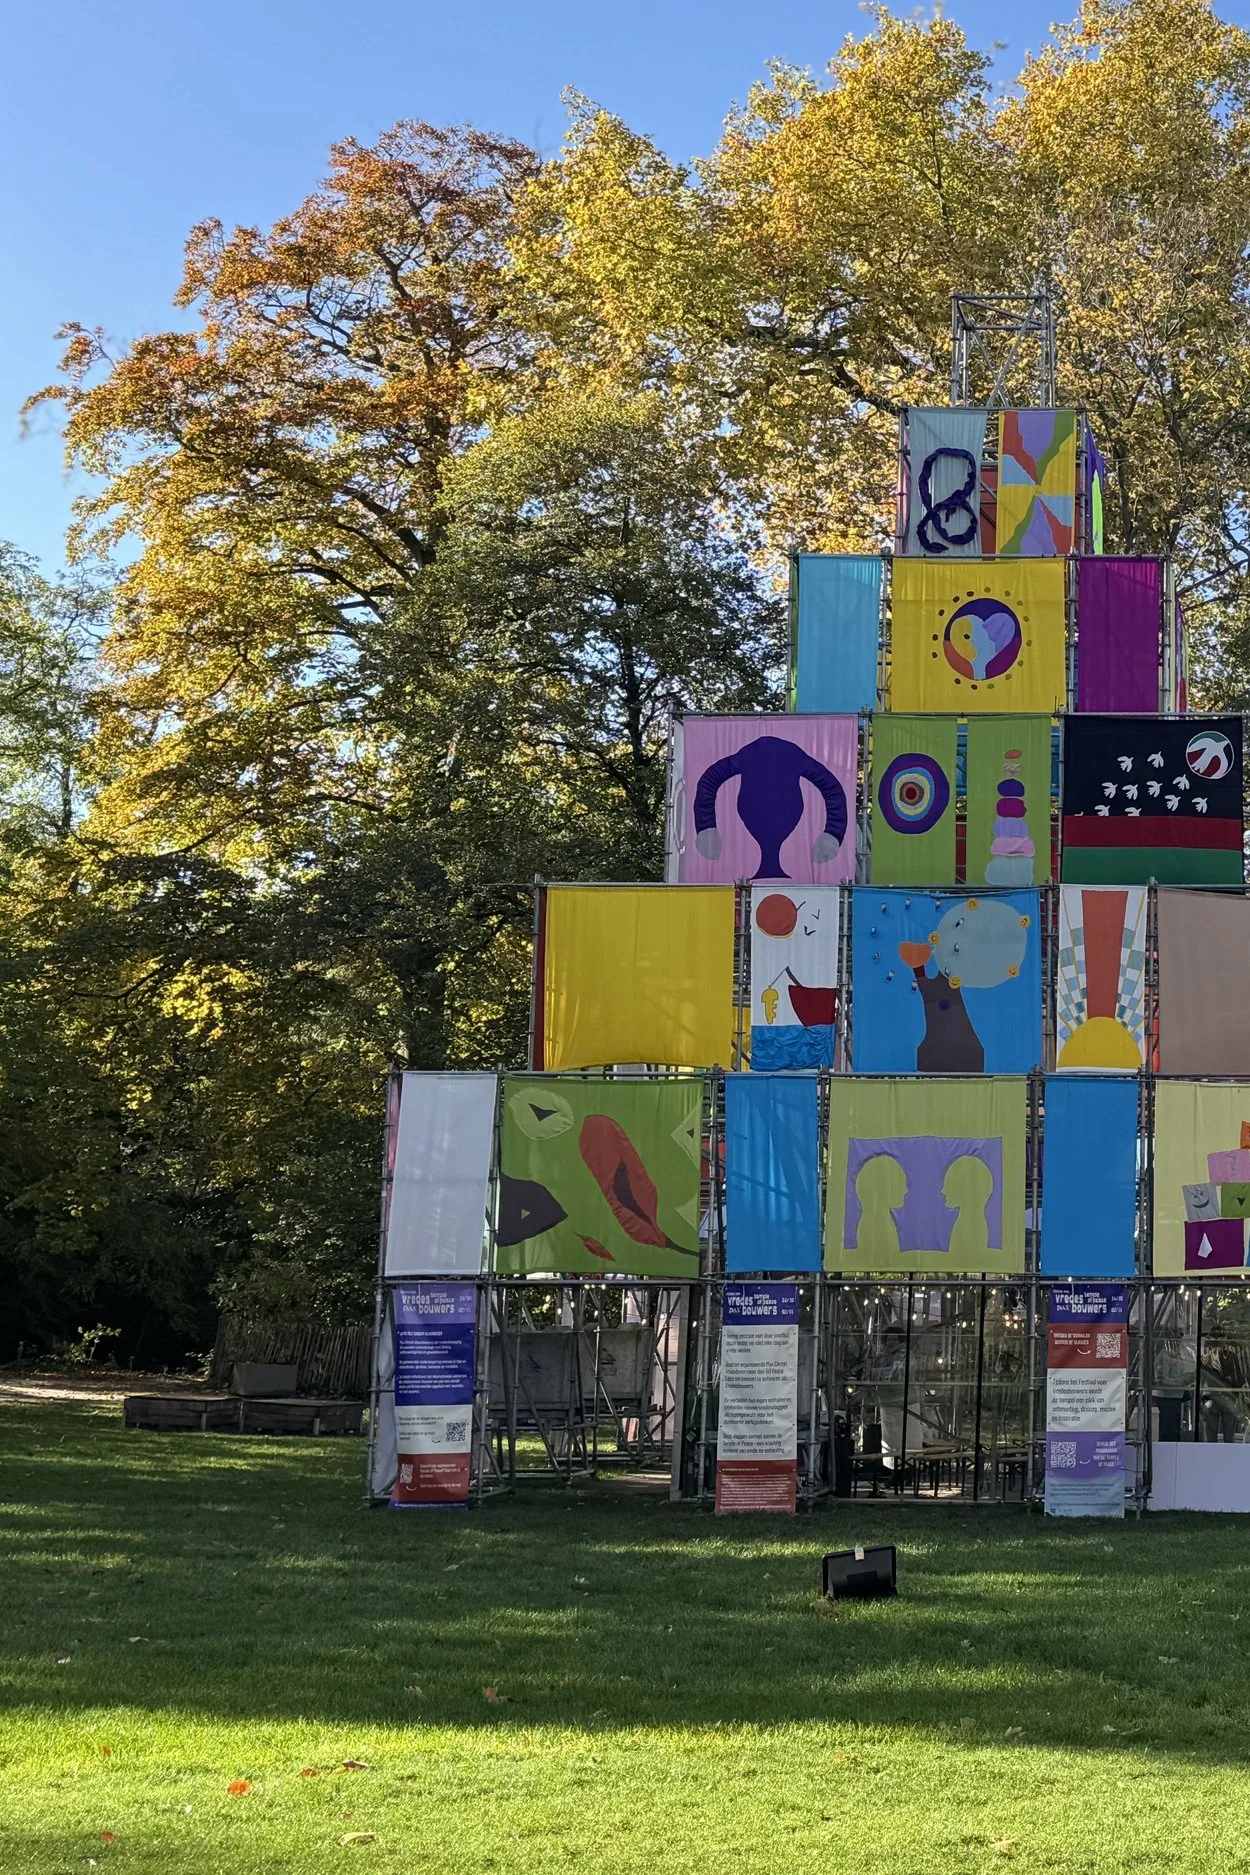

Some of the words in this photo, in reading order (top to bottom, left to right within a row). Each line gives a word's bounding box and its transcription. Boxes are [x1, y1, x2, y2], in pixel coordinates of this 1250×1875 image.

[728, 1291, 754, 1306] vredes
[1055, 1290, 1084, 1304] vredes
[419, 1304, 455, 1314] bouwers
[742, 1305, 778, 1316] bouwers
[1072, 1303, 1107, 1313] bouwers
